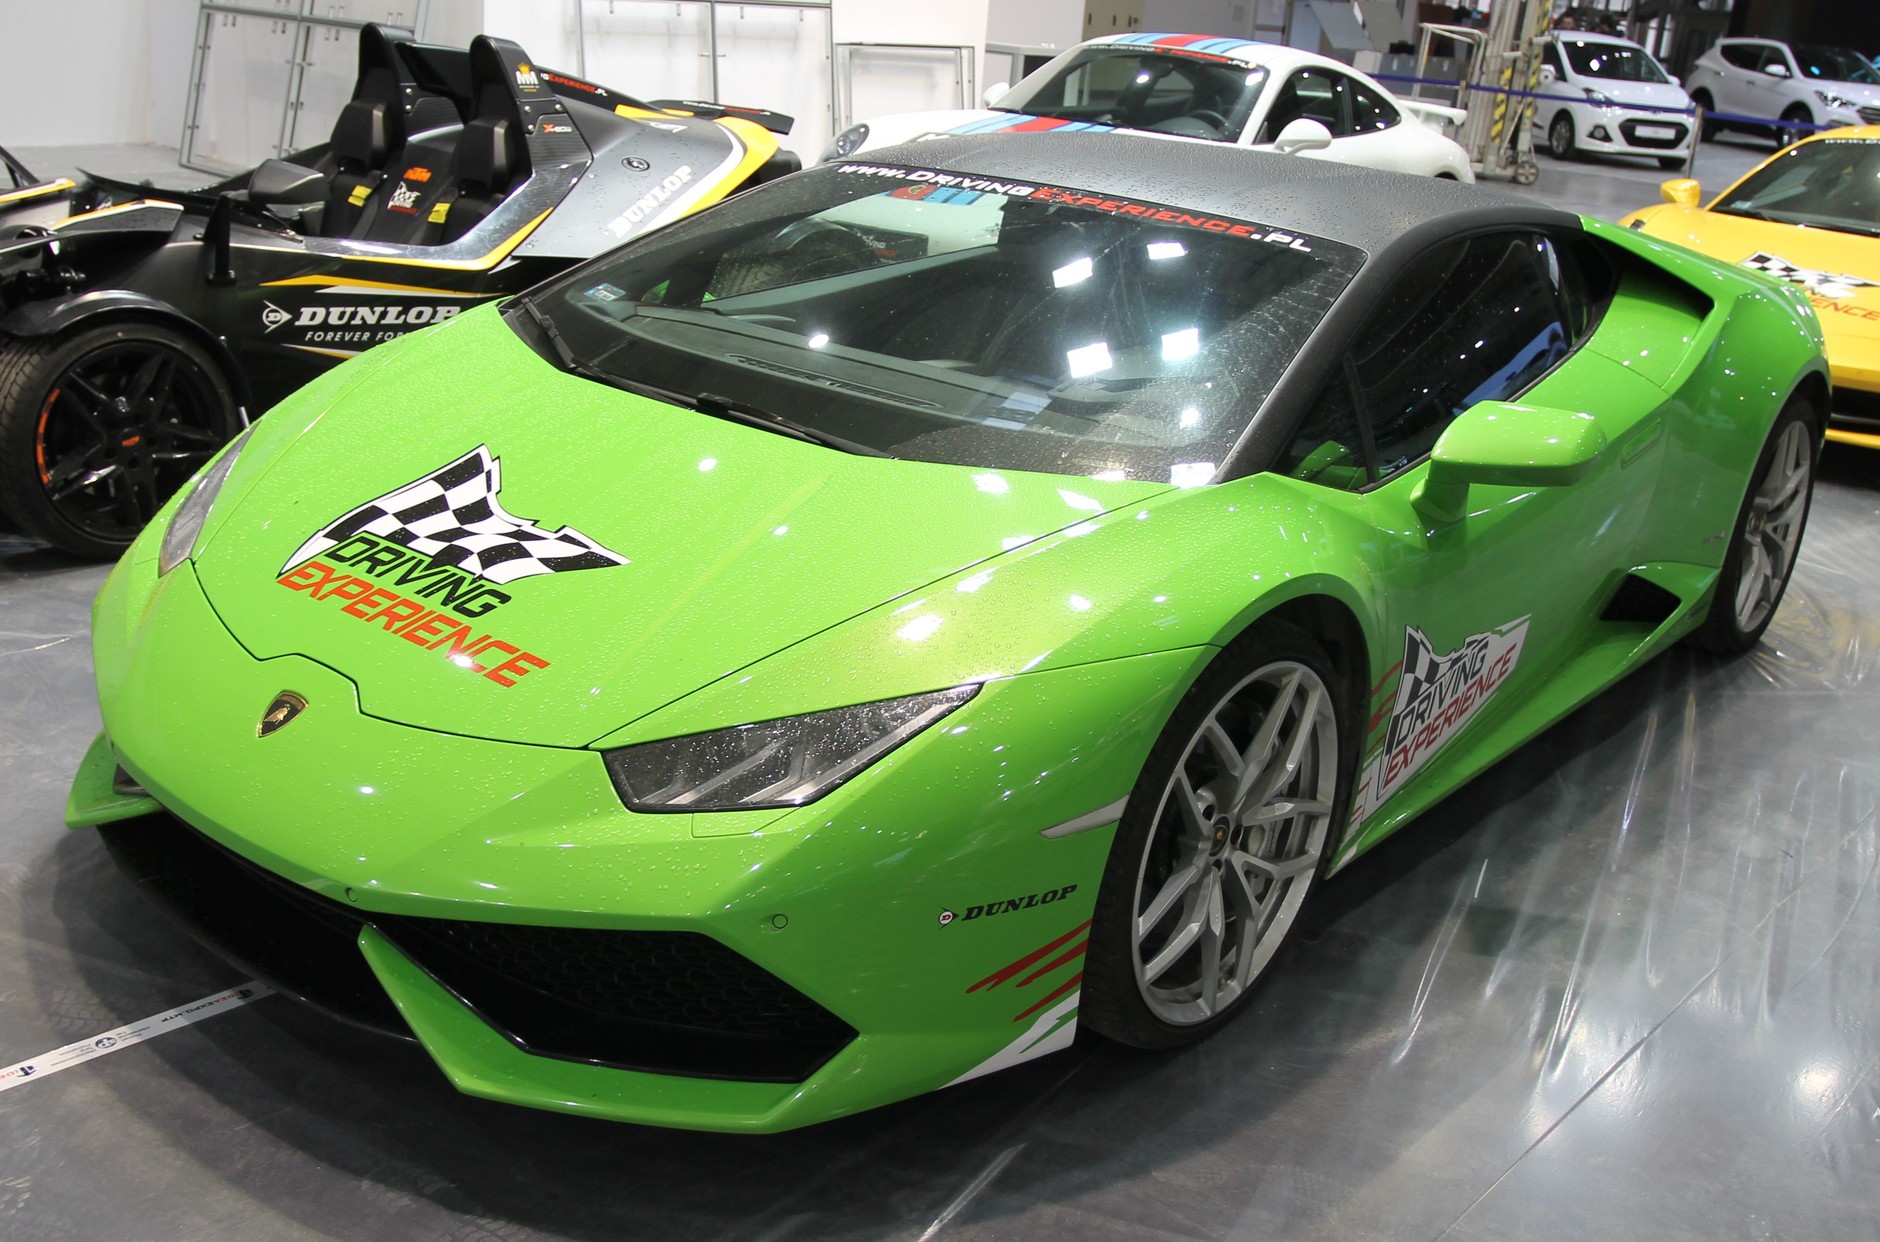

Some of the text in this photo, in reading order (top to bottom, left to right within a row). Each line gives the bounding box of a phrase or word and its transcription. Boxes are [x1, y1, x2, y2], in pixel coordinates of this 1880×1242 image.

[403, 167, 433, 182] KTM
[606, 164, 692, 239] DUNLOP
[294, 306, 461, 326] DUNLOP
[305, 332, 371, 342] FOREVER
[324, 536, 512, 618] DRIVING
[276, 561, 551, 688] EXPERIENCE
[1383, 642, 1517, 789] EXPERIENCE
[1394, 640, 1489, 750] DRIVING
[961, 884, 1078, 921] DUNLOP
